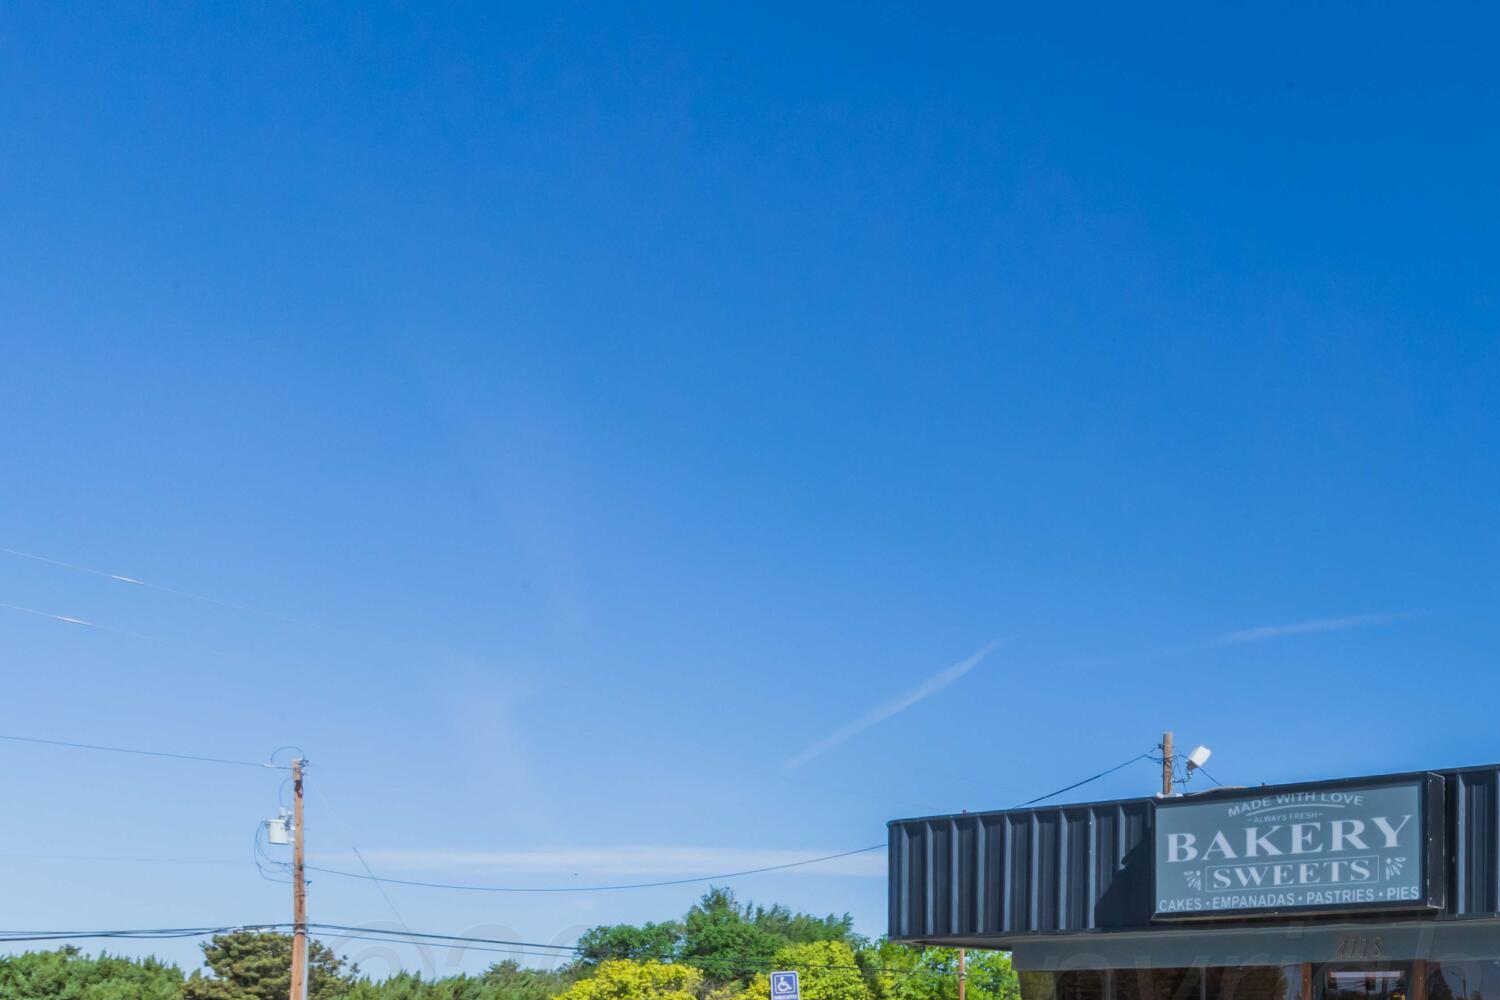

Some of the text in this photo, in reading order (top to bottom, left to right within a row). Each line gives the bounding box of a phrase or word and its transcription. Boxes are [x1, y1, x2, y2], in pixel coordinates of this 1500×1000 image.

[1227, 792, 1364, 817] MADE WITH LOVE
[1253, 812, 1318, 824] ALWAYS FRESH
[1167, 814, 1413, 863] BAKERY
[1212, 859, 1371, 889] SWEETS
[1159, 886, 1420, 912] CAKES EMPANADAS PASTRIES PIES
